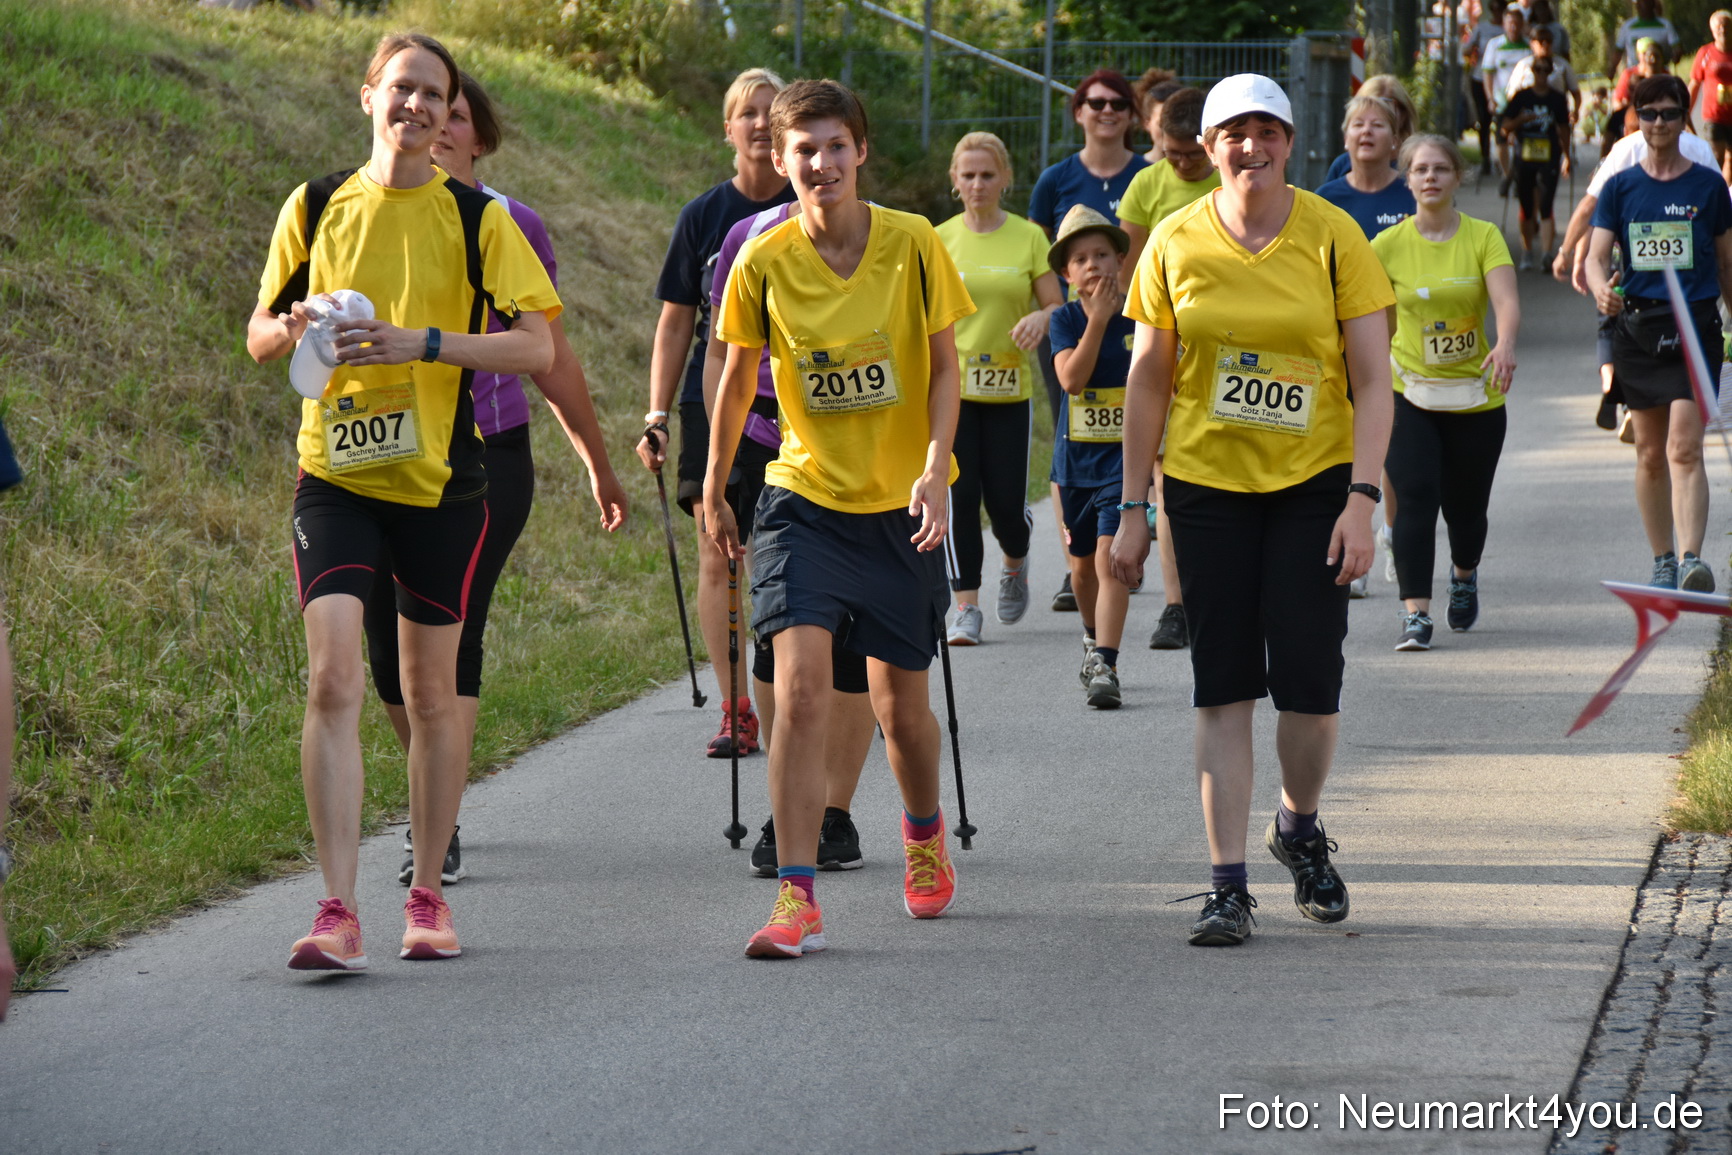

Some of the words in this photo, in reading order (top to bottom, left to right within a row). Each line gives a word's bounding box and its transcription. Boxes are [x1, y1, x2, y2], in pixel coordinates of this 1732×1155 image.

[1664, 203, 1685, 215] vhs
[1377, 213, 1397, 224] vhs
[1637, 239, 1683, 257] 2393
[1430, 331, 1475, 354] 1230
[972, 368, 1016, 386] 1274
[1231, 361, 1273, 375] firmenlauf
[808, 364, 885, 397] 2019
[818, 396, 852, 405] Schröder
[855, 391, 885, 402] Hannah
[1222, 375, 1304, 412] 2006
[1085, 407, 1124, 427] 388
[1215, 409, 1279, 425] Regens-Wagner-Stiftung
[1280, 420, 1305, 428] Holnstein
[1240, 406, 1259, 416] Götz
[1261, 409, 1283, 420] Tanja
[333, 412, 404, 451] 2007
[332, 451, 391, 467] Regens-Wagner-Stiftung
[346, 447, 376, 458] Gschrey
[378, 442, 399, 452] Maria
